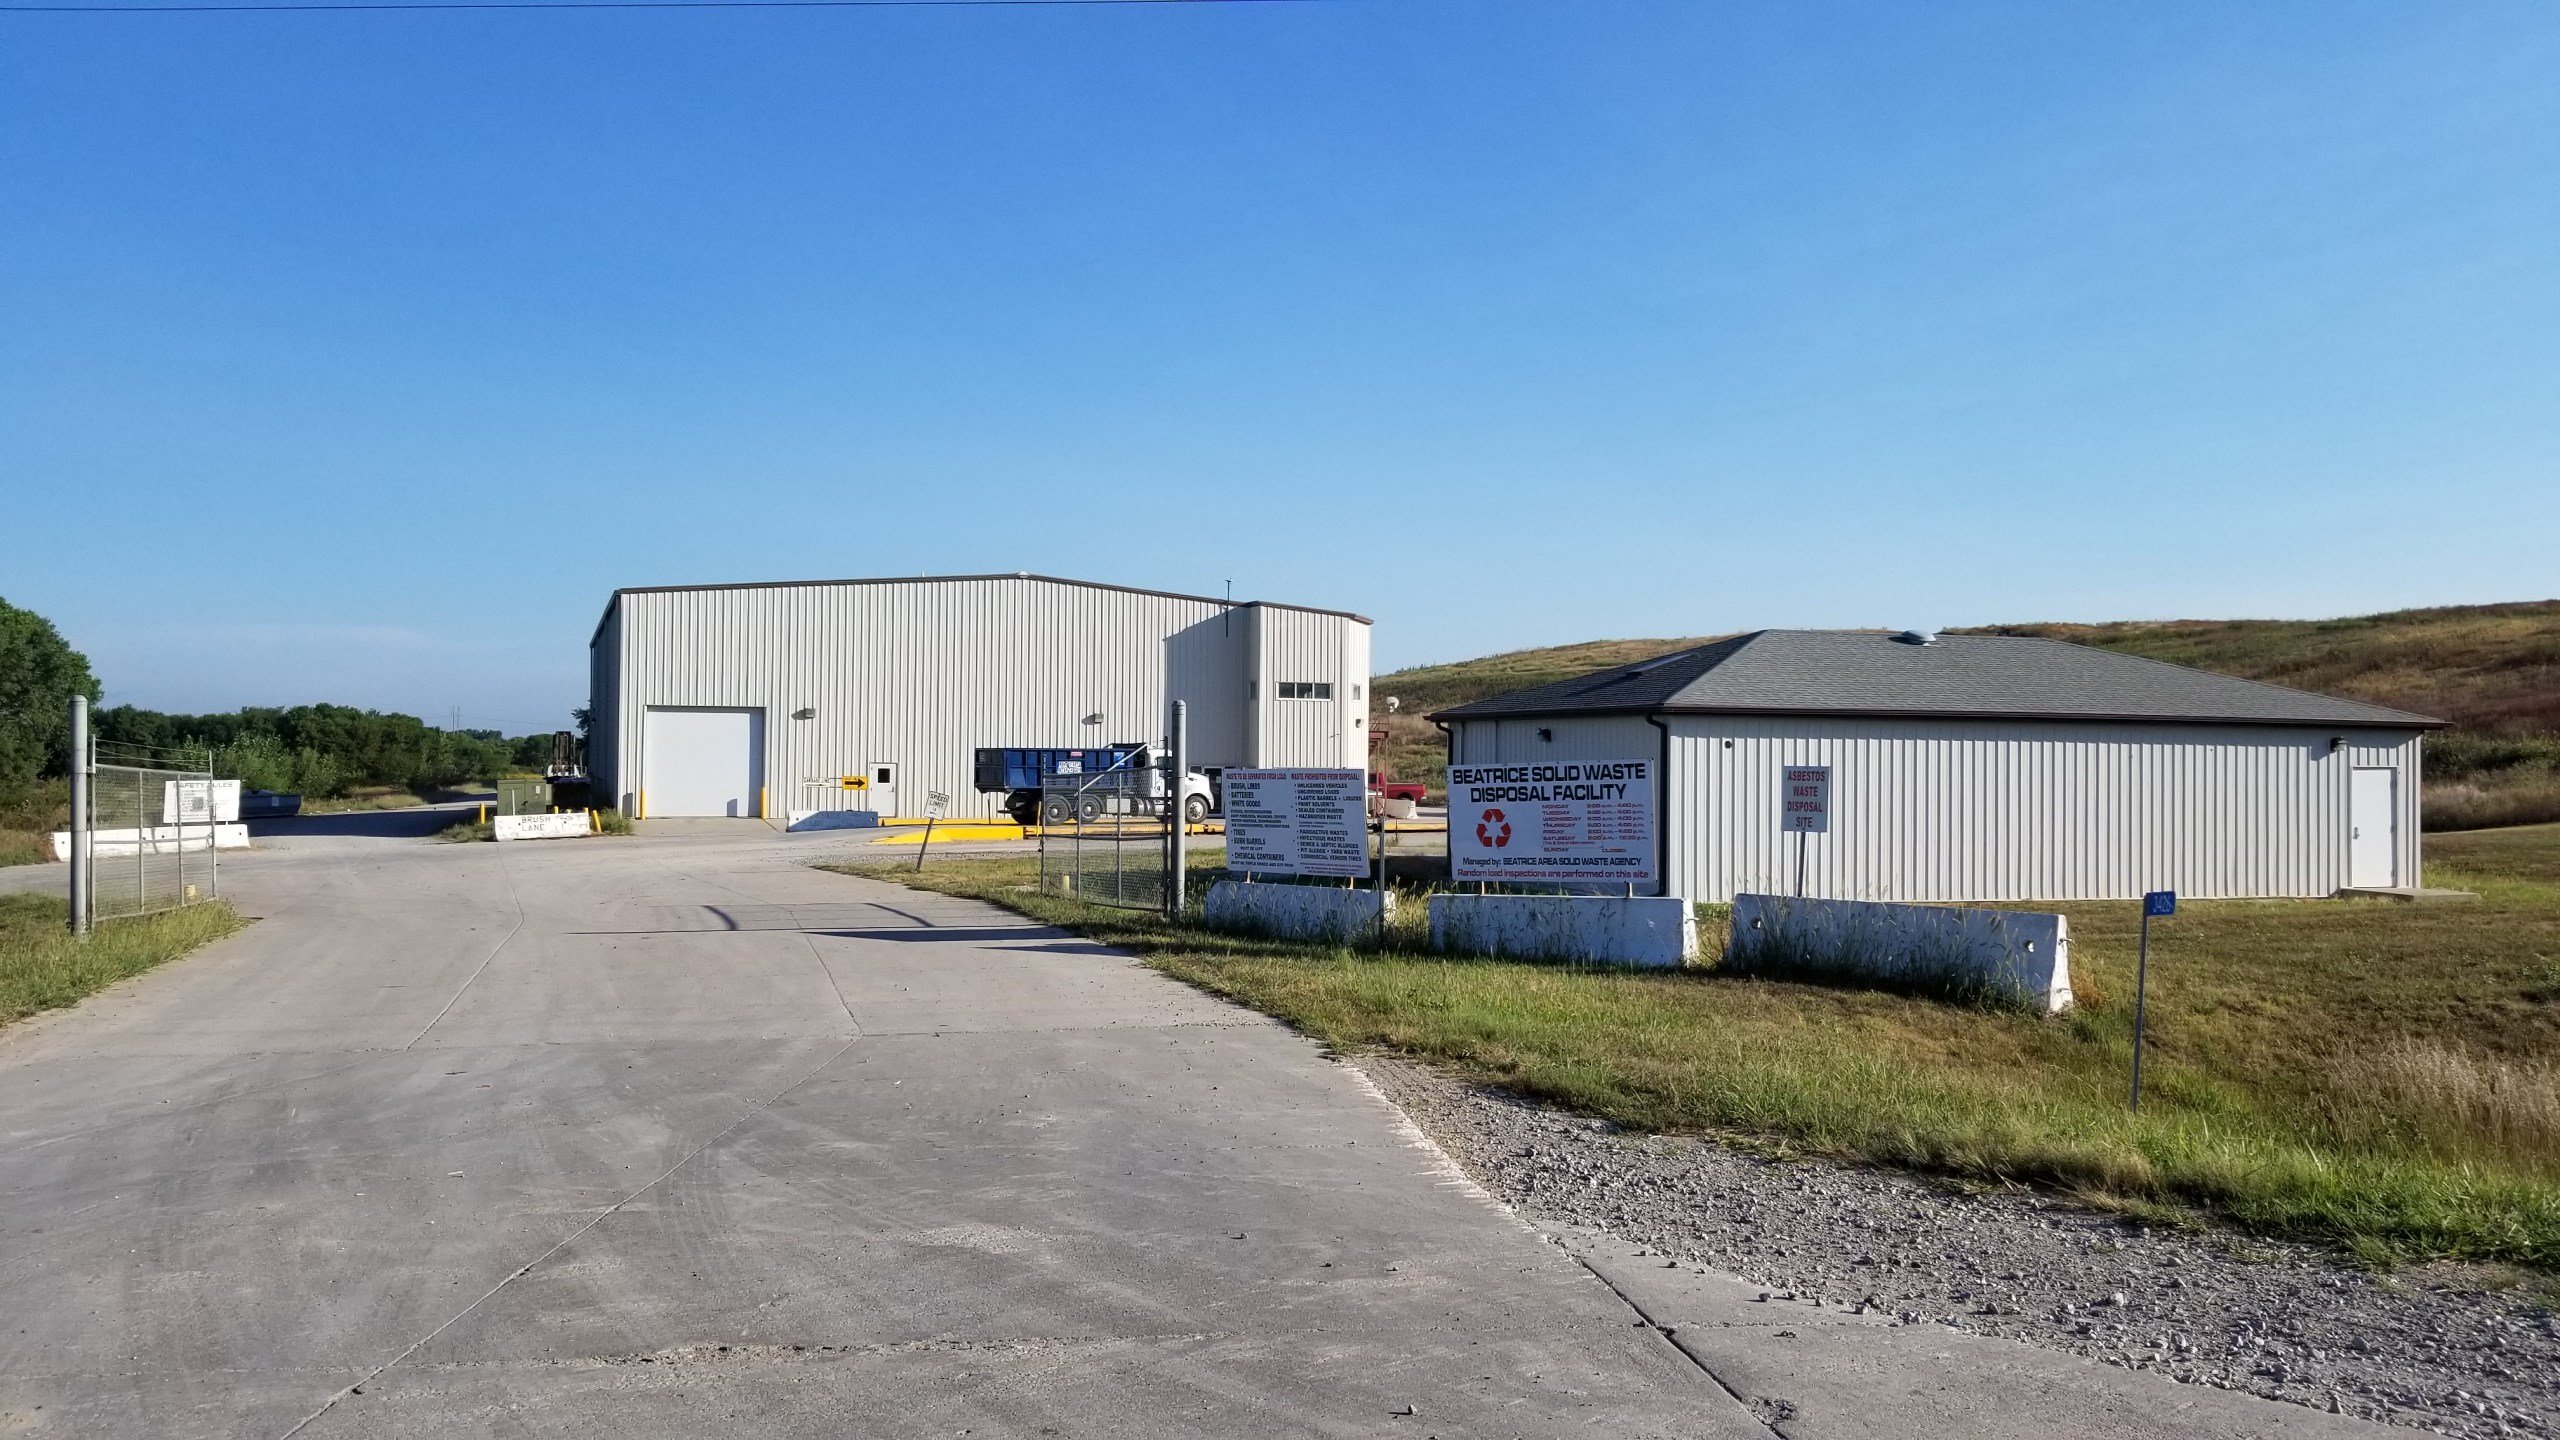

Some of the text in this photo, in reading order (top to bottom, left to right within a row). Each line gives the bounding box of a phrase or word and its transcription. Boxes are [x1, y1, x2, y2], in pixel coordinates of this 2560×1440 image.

[1453, 763, 1646, 784] BEATRICE SOLID WASTE
[1787, 771, 1825, 781] ASBESTOS
[1470, 784, 1626, 802] DISPOSAL FACILITY
[1793, 786, 1818, 796] WASTE
[930, 794, 948, 802] SPEED
[1788, 801, 1822, 812] DISPOSAL
[1796, 817, 1812, 827] SITE
[1462, 857, 1491, 867] Managed
[1492, 858, 1500, 867] by:
[1582, 858, 1608, 866] WASTE
[1610, 857, 1641, 866] AGENCY
[1504, 869, 1546, 878] inspections
[1562, 869, 1603, 878] performed
[1616, 870, 1631, 878] this
[1633, 870, 1648, 878] site
